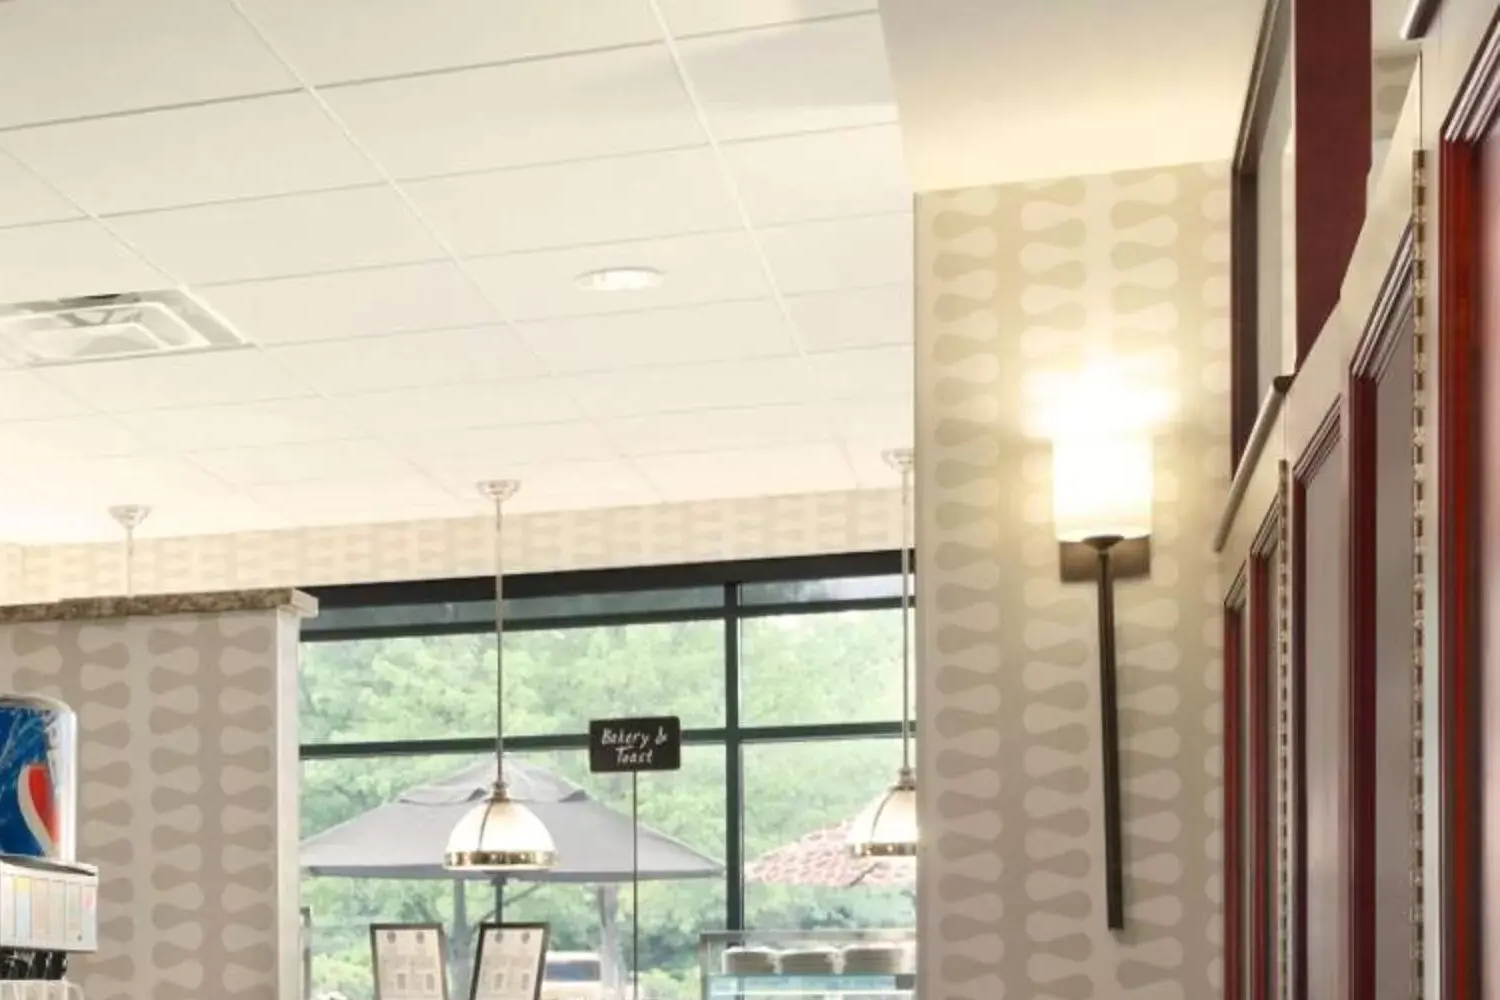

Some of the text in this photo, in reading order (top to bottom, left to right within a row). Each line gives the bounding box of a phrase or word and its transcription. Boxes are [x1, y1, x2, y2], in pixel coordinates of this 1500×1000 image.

[601, 726, 668, 750] Bakery &
[615, 747, 653, 765] Toast
